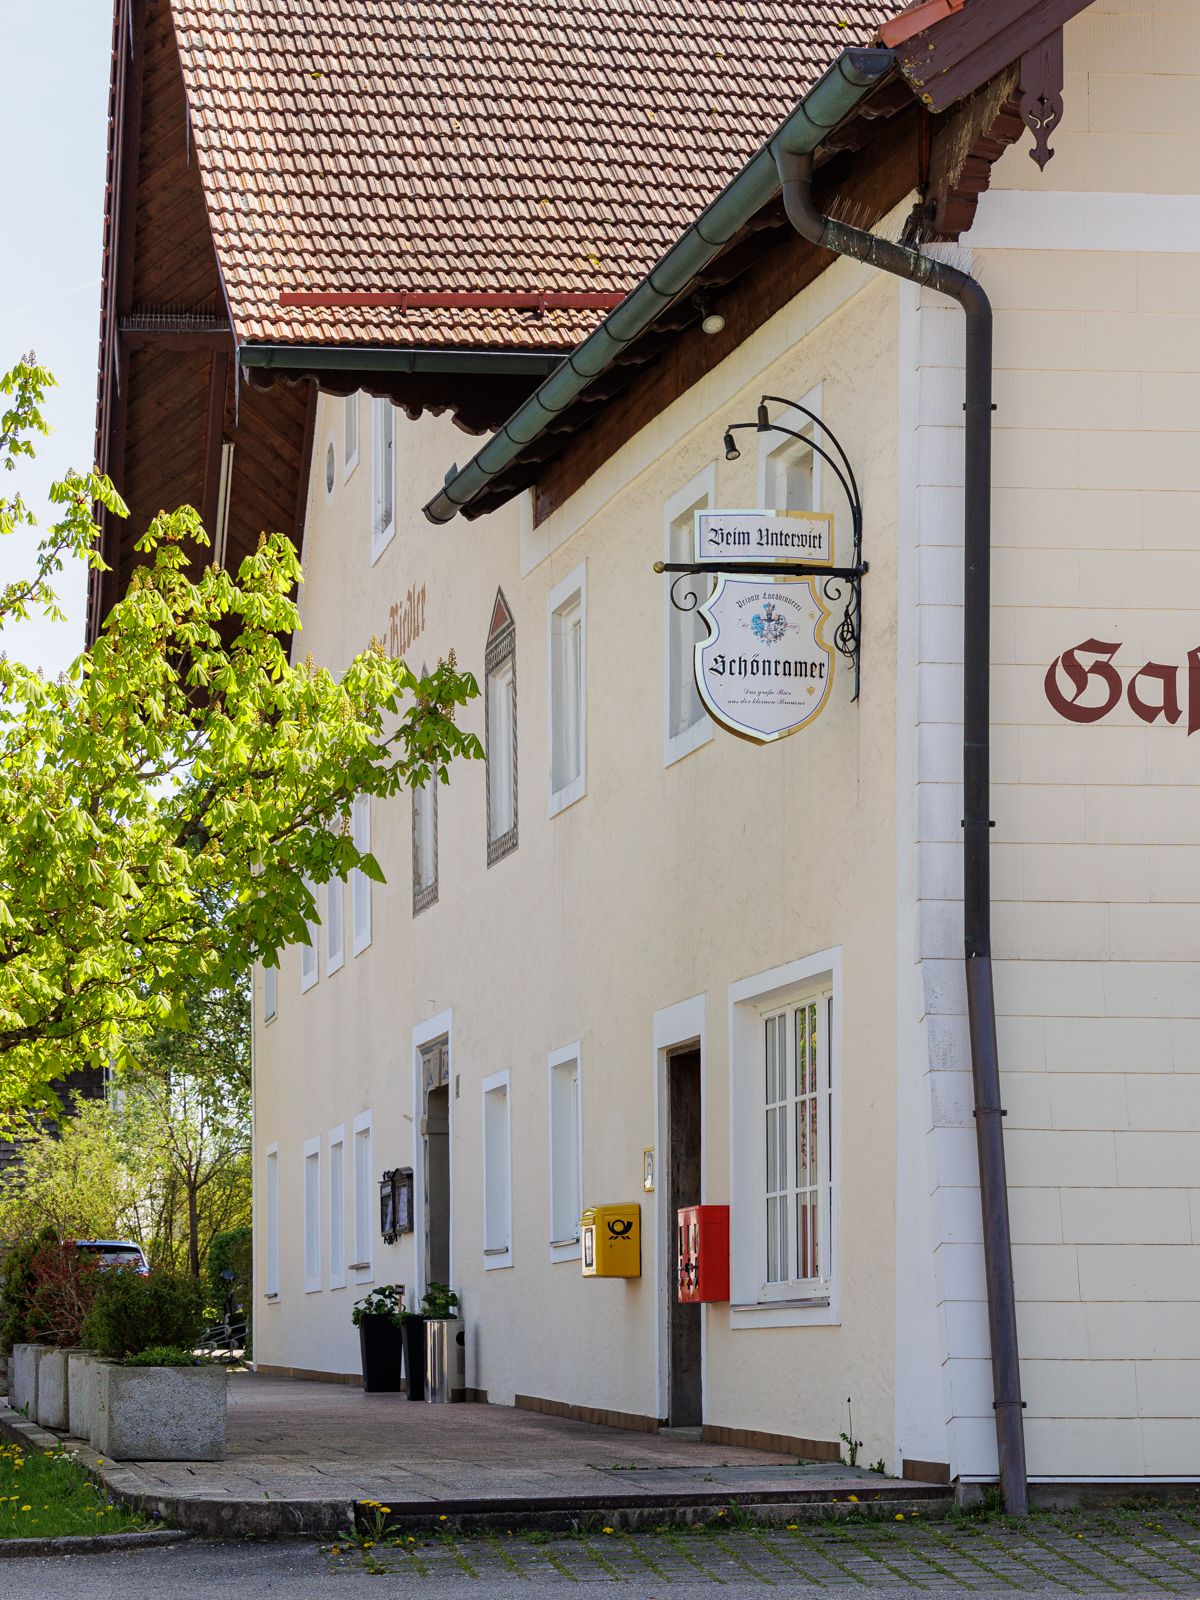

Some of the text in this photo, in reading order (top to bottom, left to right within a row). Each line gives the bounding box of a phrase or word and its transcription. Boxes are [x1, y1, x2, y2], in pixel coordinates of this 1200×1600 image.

[708, 527, 822, 549] Beim Unterwirt
[708, 652, 825, 680] Schönramer
